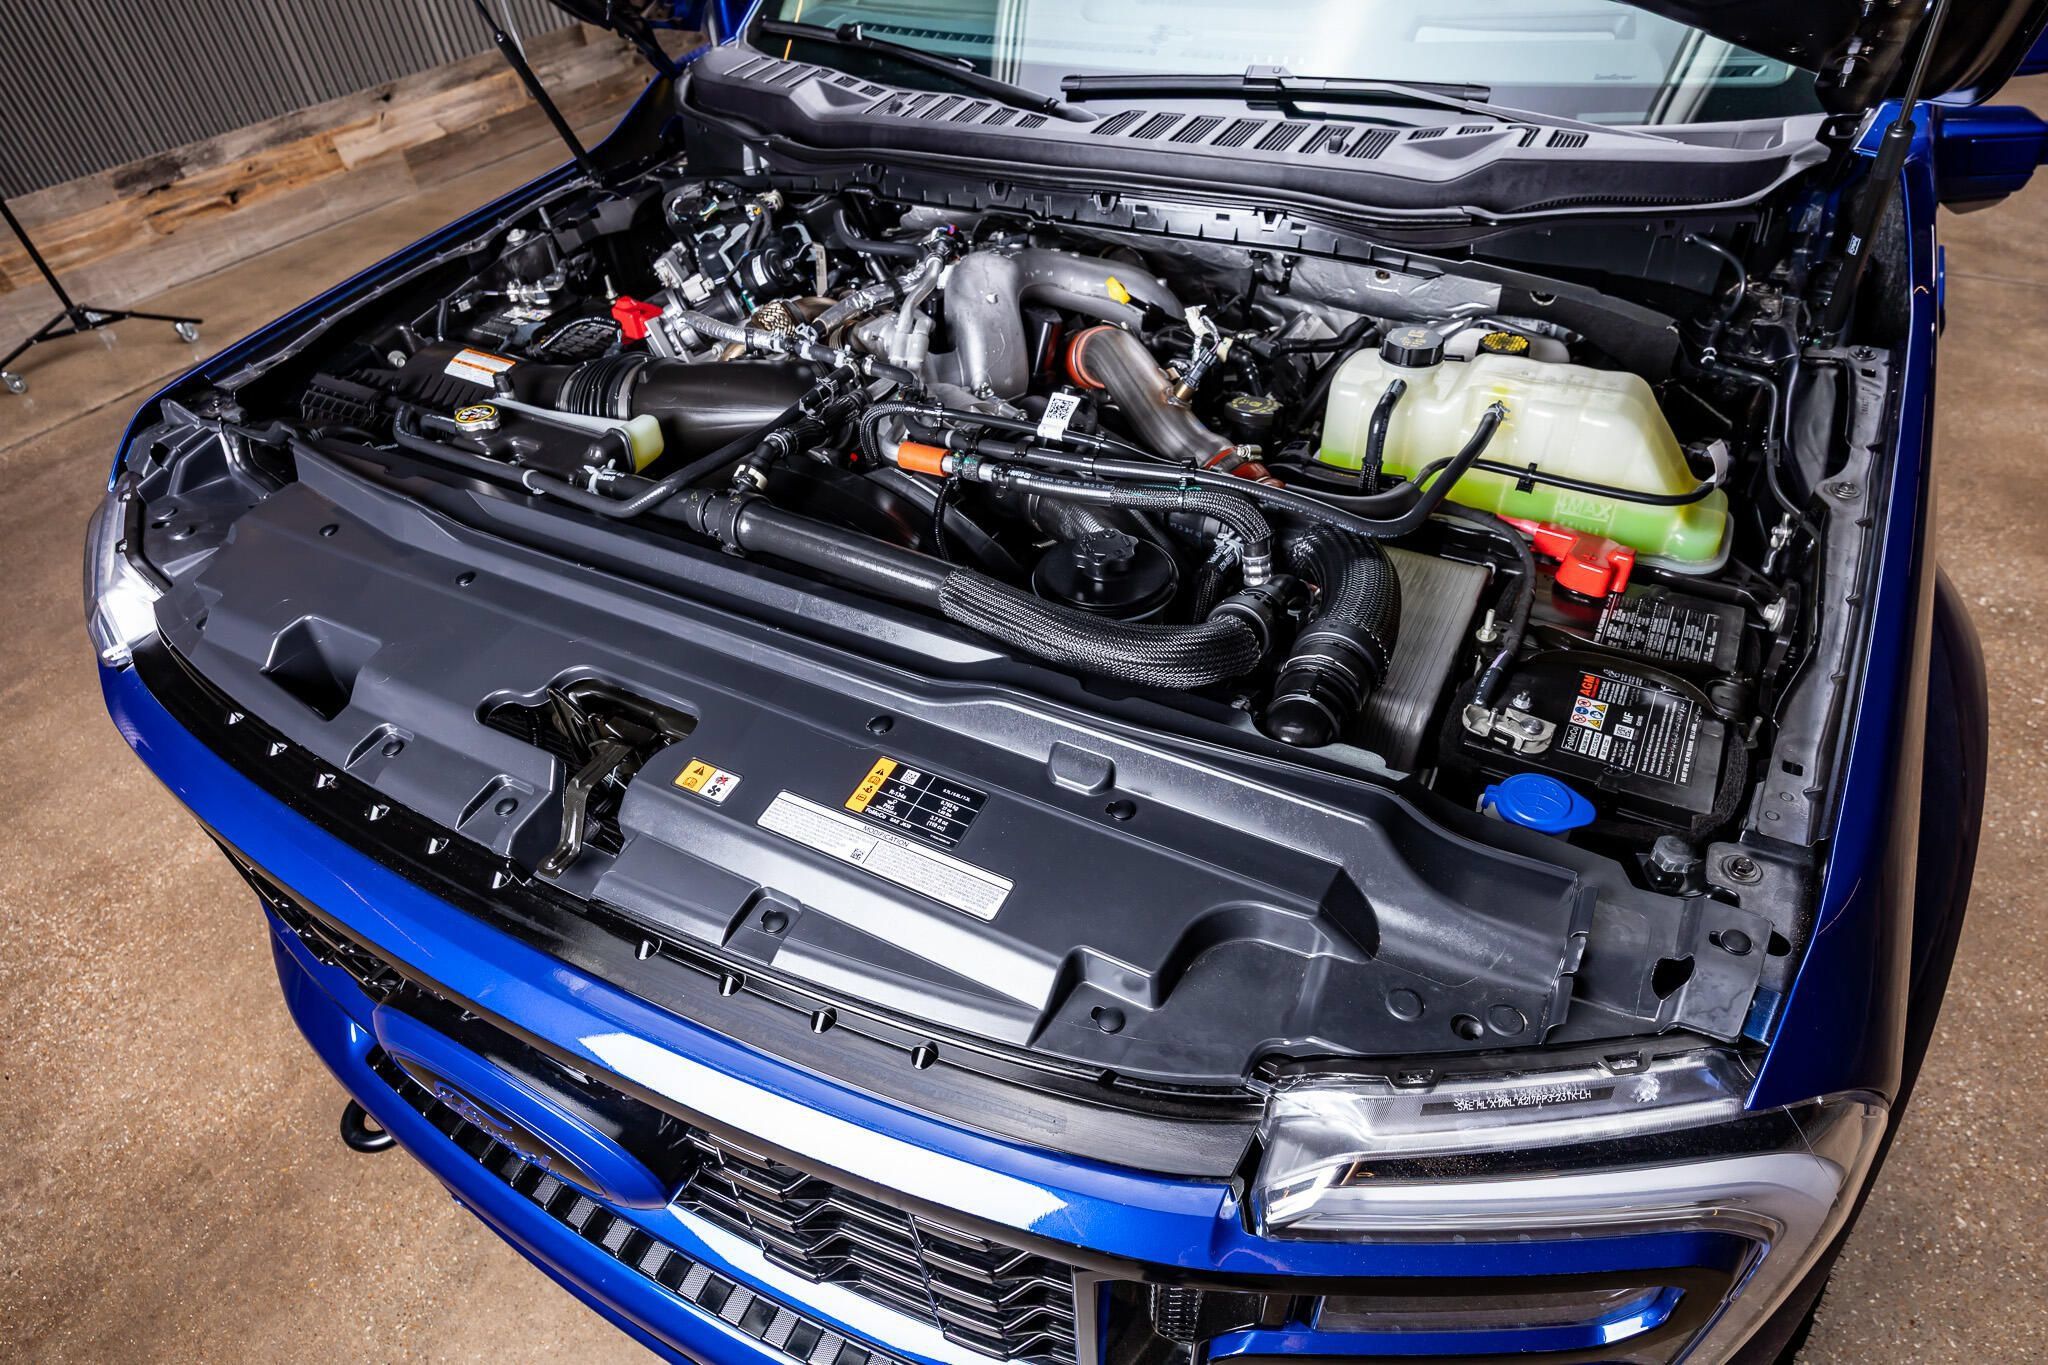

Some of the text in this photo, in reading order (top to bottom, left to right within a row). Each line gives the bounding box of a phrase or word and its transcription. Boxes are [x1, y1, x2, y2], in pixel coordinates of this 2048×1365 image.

[1580, 675, 1595, 696] AGM
[1565, 727, 1579, 750] FoMoCo
[889, 789, 907, 800] R-134a
[865, 807, 887, 819] FoMoCo
[883, 802, 895, 811] PAG
[926, 820, 938, 828] (110
[863, 825, 910, 848] MODIFICATION
[1457, 1100, 1474, 1111] SAE
[1477, 1100, 1488, 1110] HL
[1498, 1097, 1515, 1108] DRL
[1580, 1089, 1592, 1099] LH
